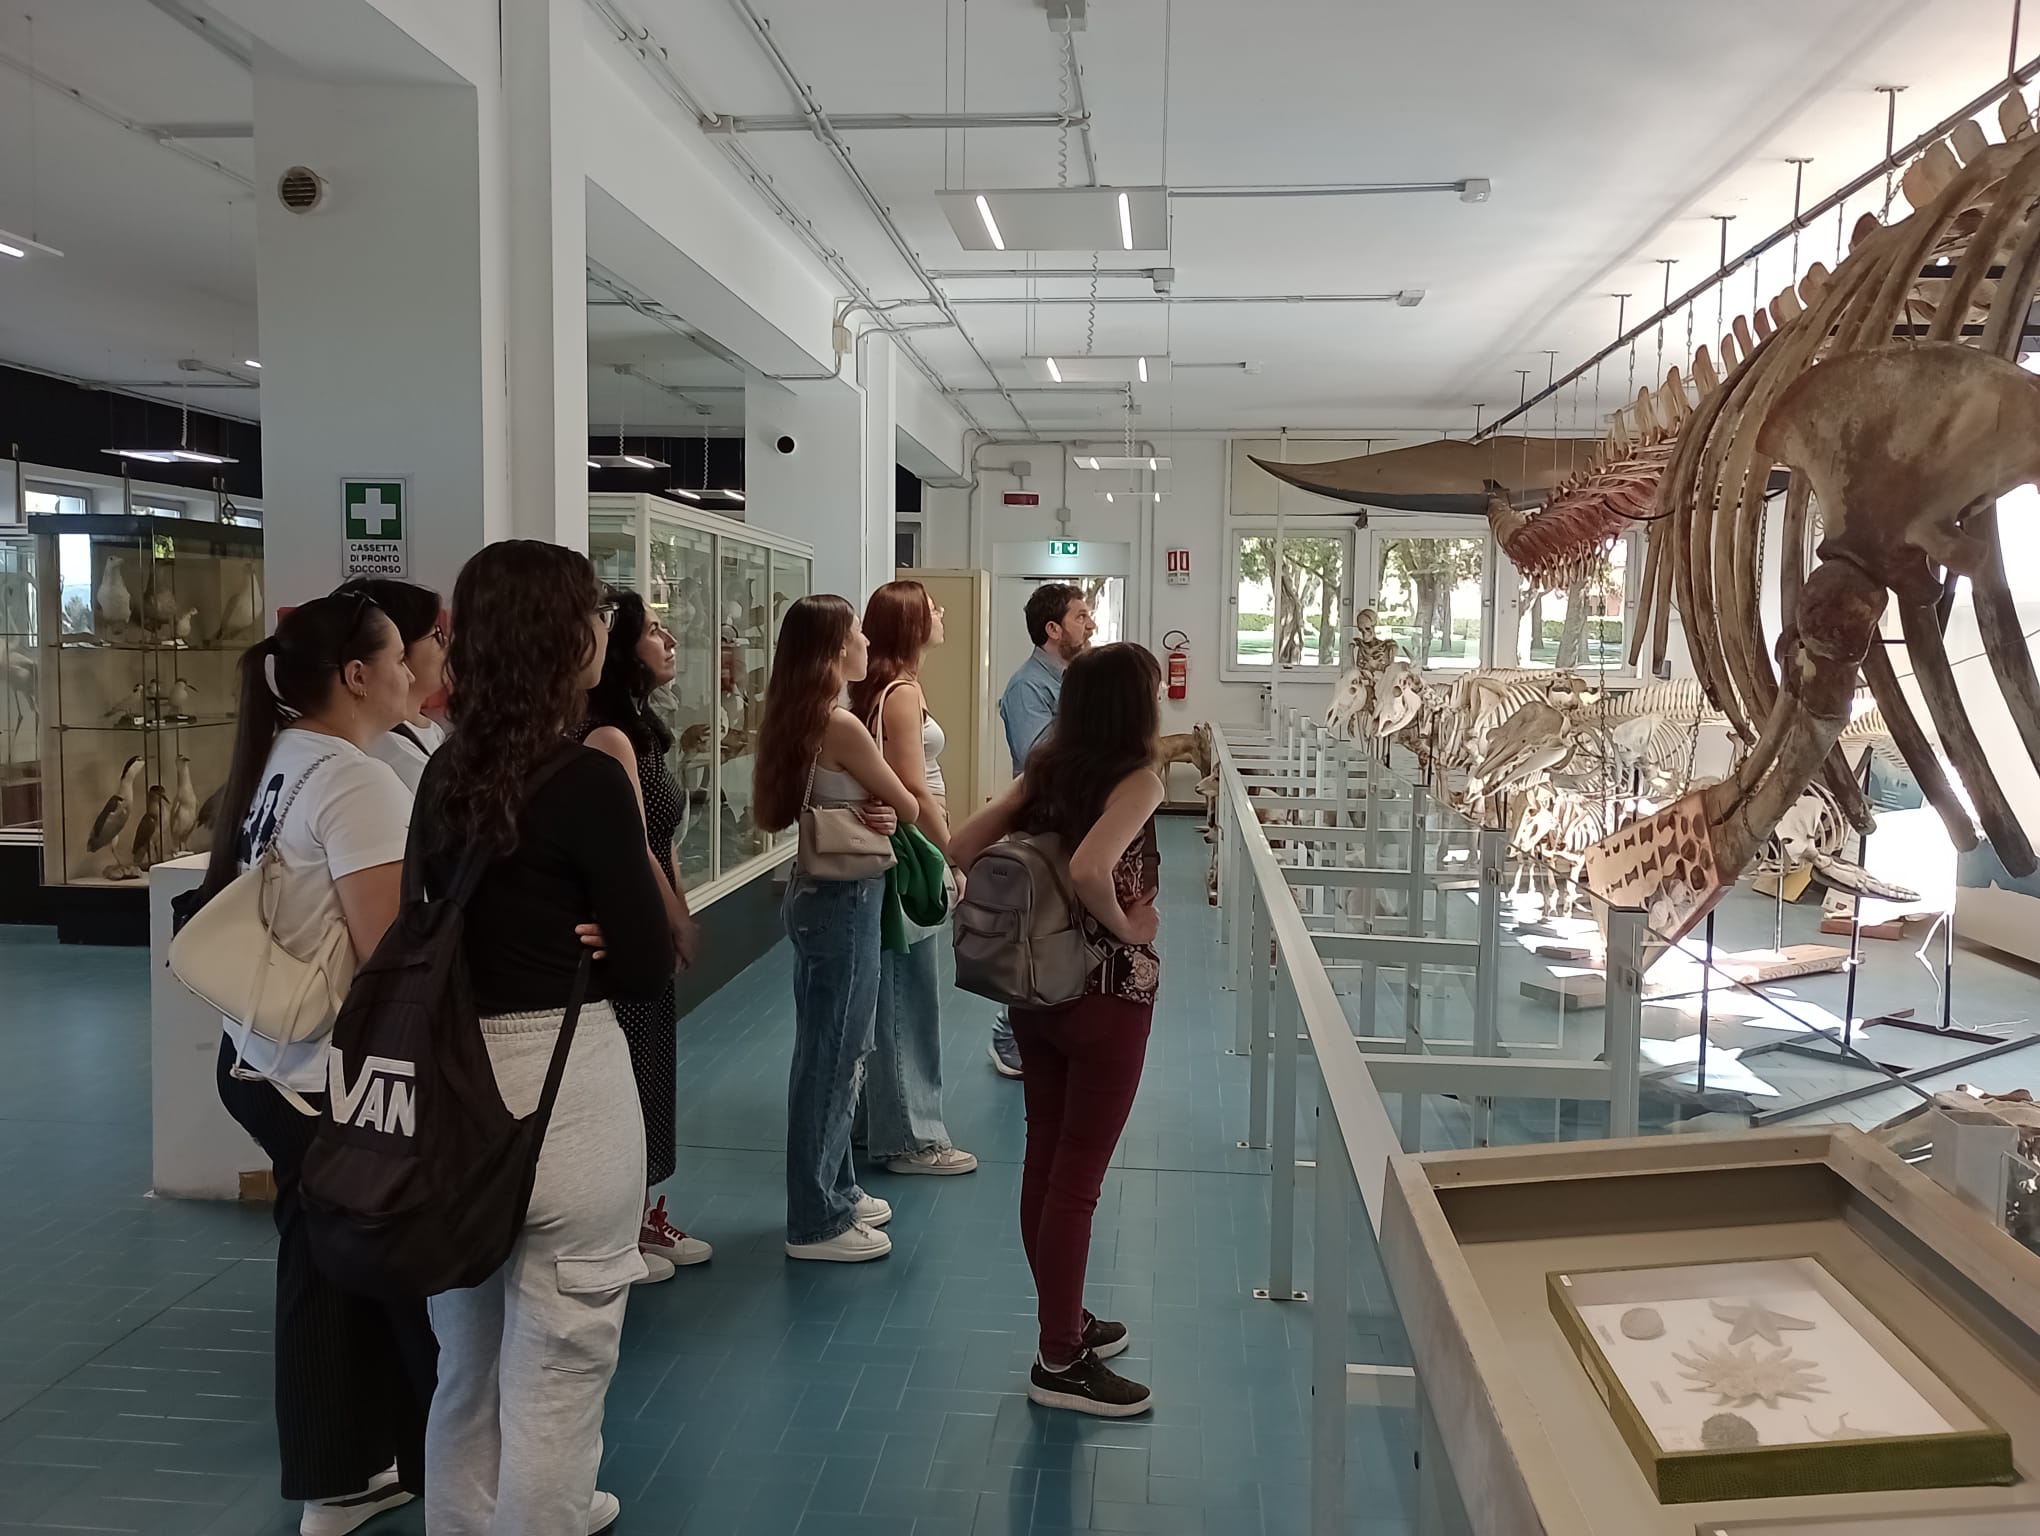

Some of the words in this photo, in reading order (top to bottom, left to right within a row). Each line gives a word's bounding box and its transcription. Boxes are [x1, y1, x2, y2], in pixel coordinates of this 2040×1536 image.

[350, 543, 398, 552] CASSETTA
[350, 554, 359, 562] DI
[361, 554, 400, 563] PRONTO
[349, 565, 401, 573] SOCCORSO
